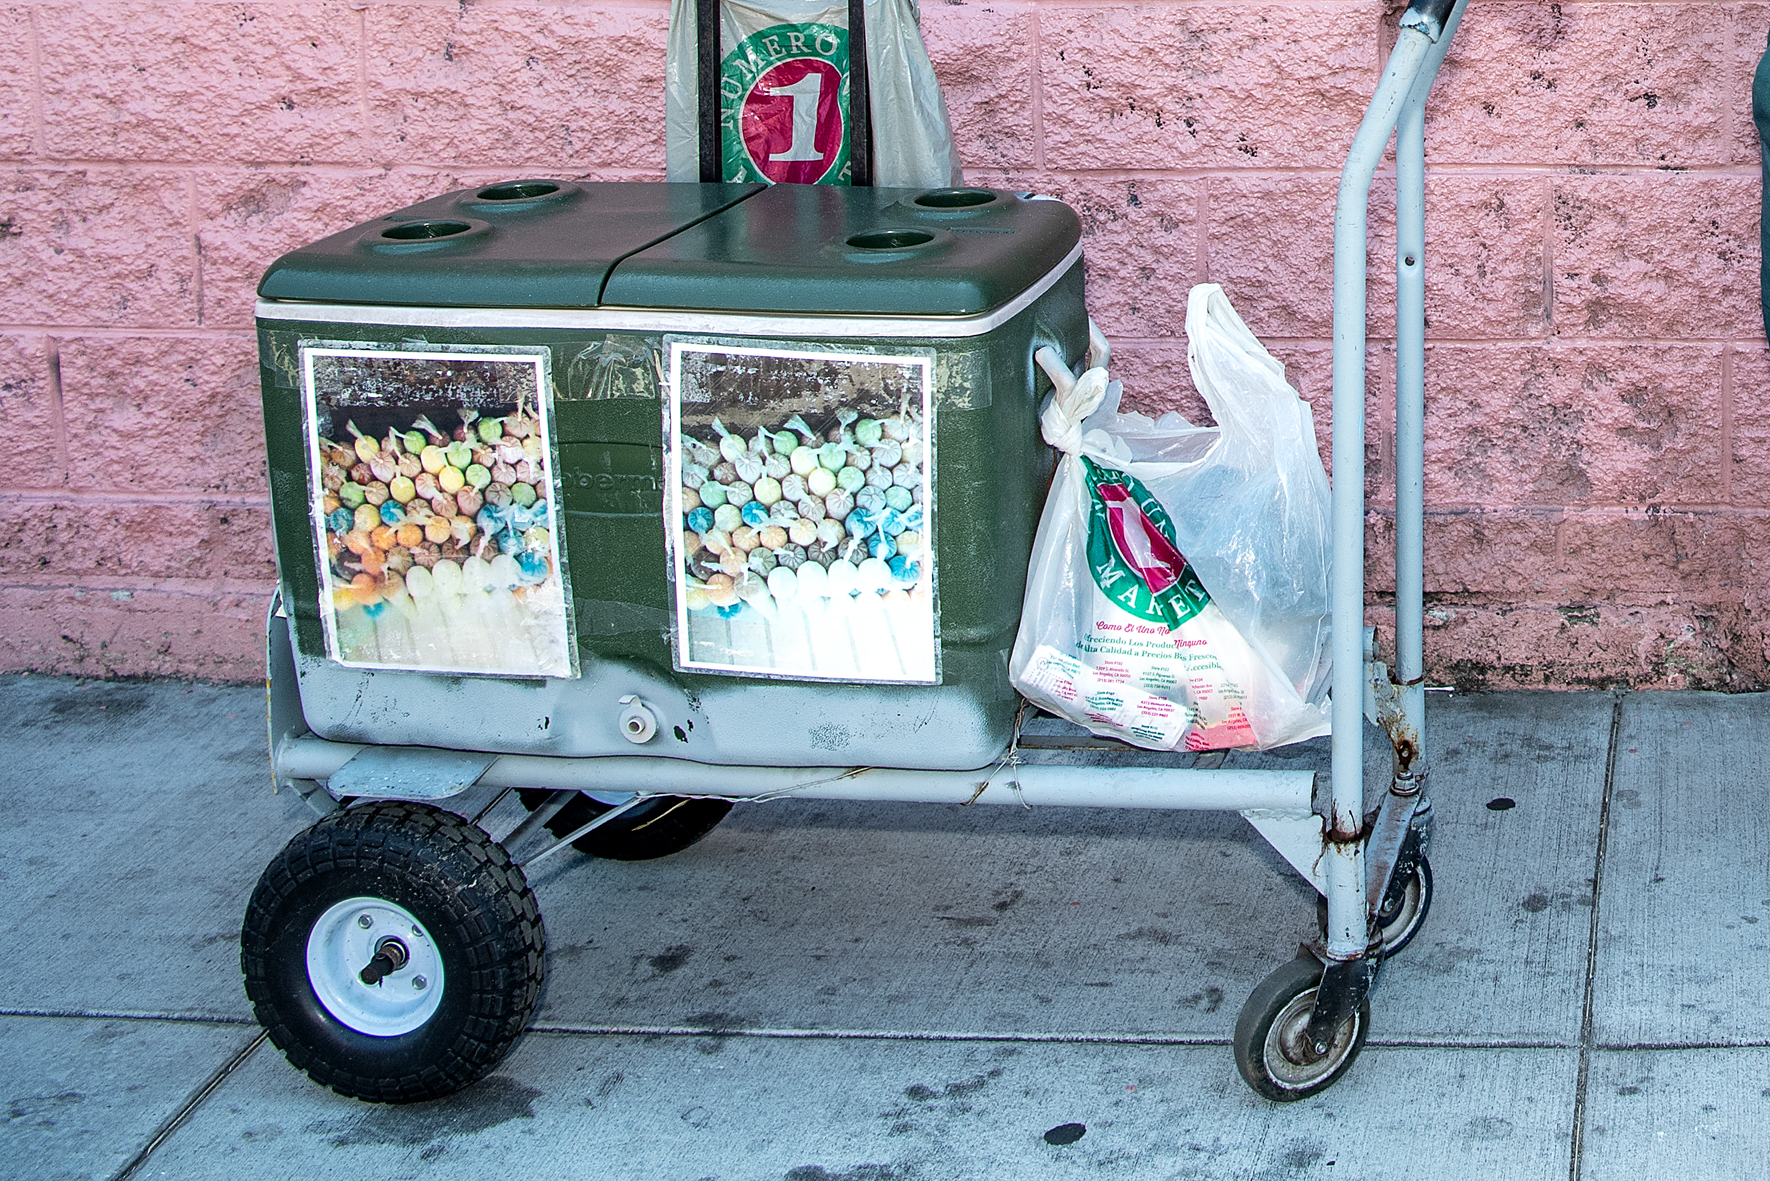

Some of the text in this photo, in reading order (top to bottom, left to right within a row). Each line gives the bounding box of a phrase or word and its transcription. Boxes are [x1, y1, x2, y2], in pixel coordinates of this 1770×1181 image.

[769, 73, 823, 161] 1
[1096, 621, 1122, 631] Como
[1124, 623, 1134, 633] El
[1136, 625, 1155, 634] Uno
[1174, 639, 1208, 649] Ninguno
[1129, 638, 1143, 648] Los
[1100, 646, 1133, 656] Calidad
[1141, 648, 1172, 659] Precios
